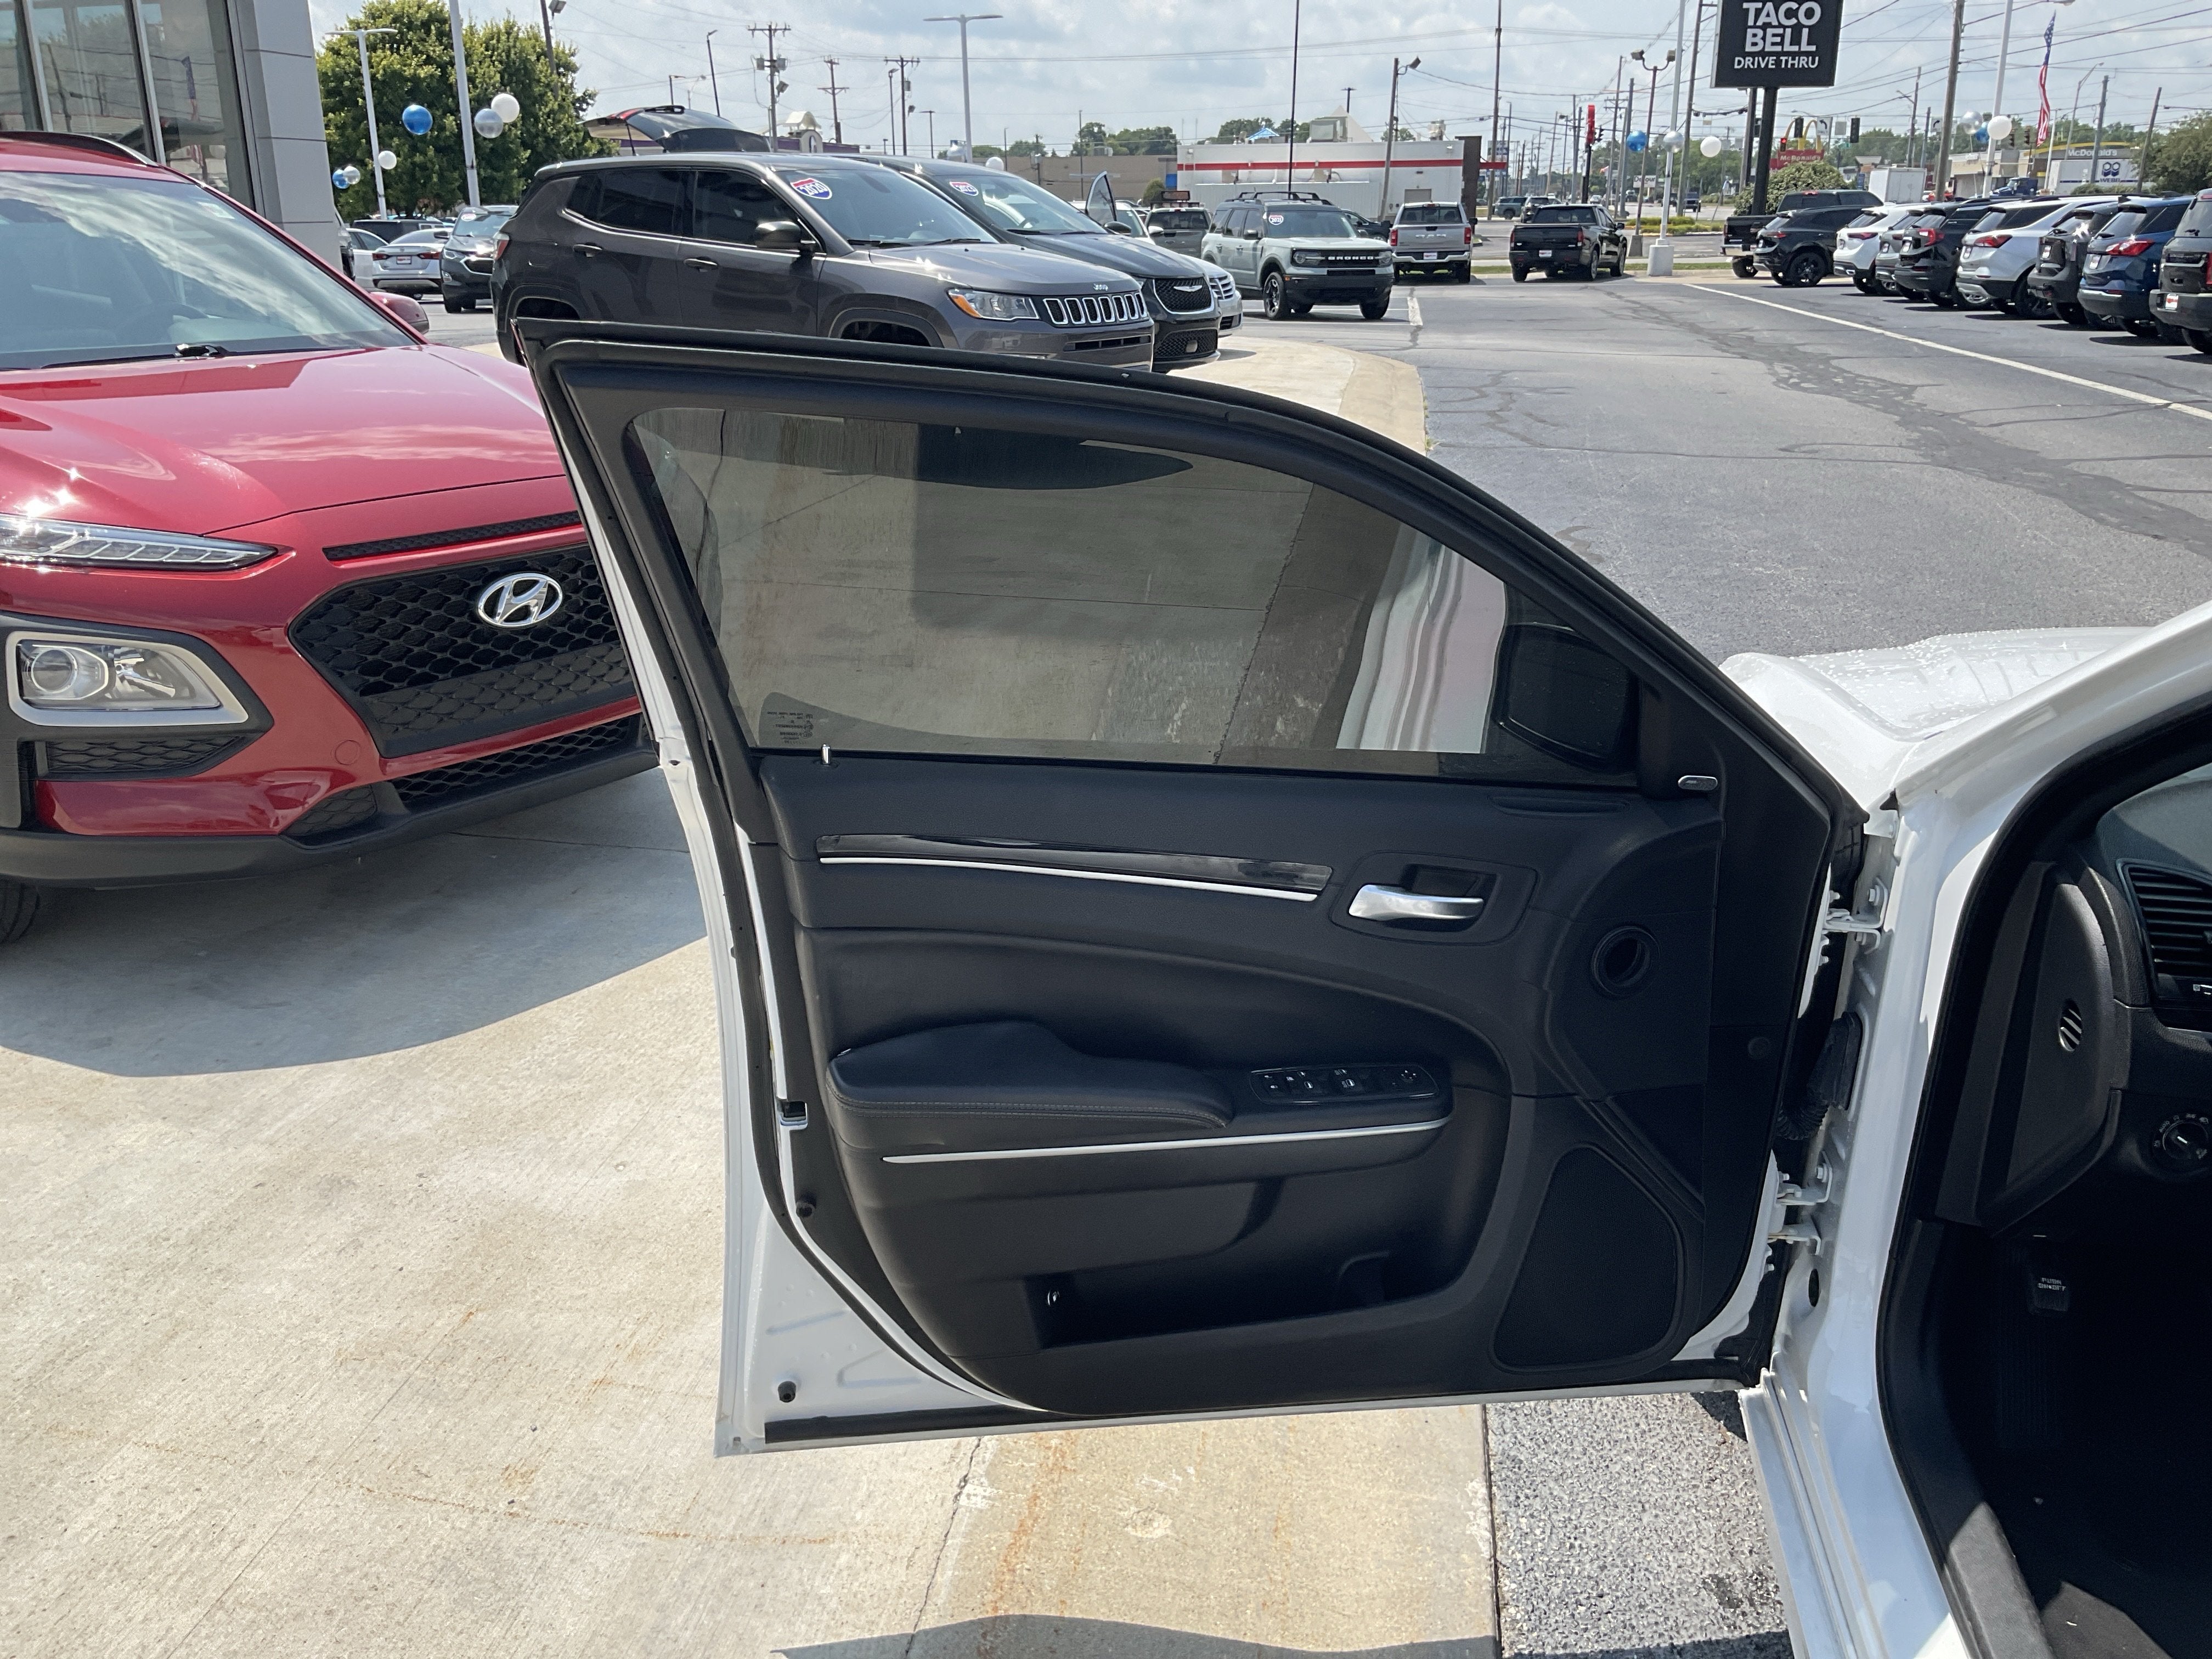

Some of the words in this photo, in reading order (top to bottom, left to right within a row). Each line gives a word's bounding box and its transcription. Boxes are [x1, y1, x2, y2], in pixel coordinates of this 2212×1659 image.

[1742, 1, 1821, 26] TACO
[1745, 27, 1816, 52] BELL
[1734, 57, 1776, 69] DRIVE
[1780, 56, 1819, 68] THRU
[799, 182, 828, 195] 2020
